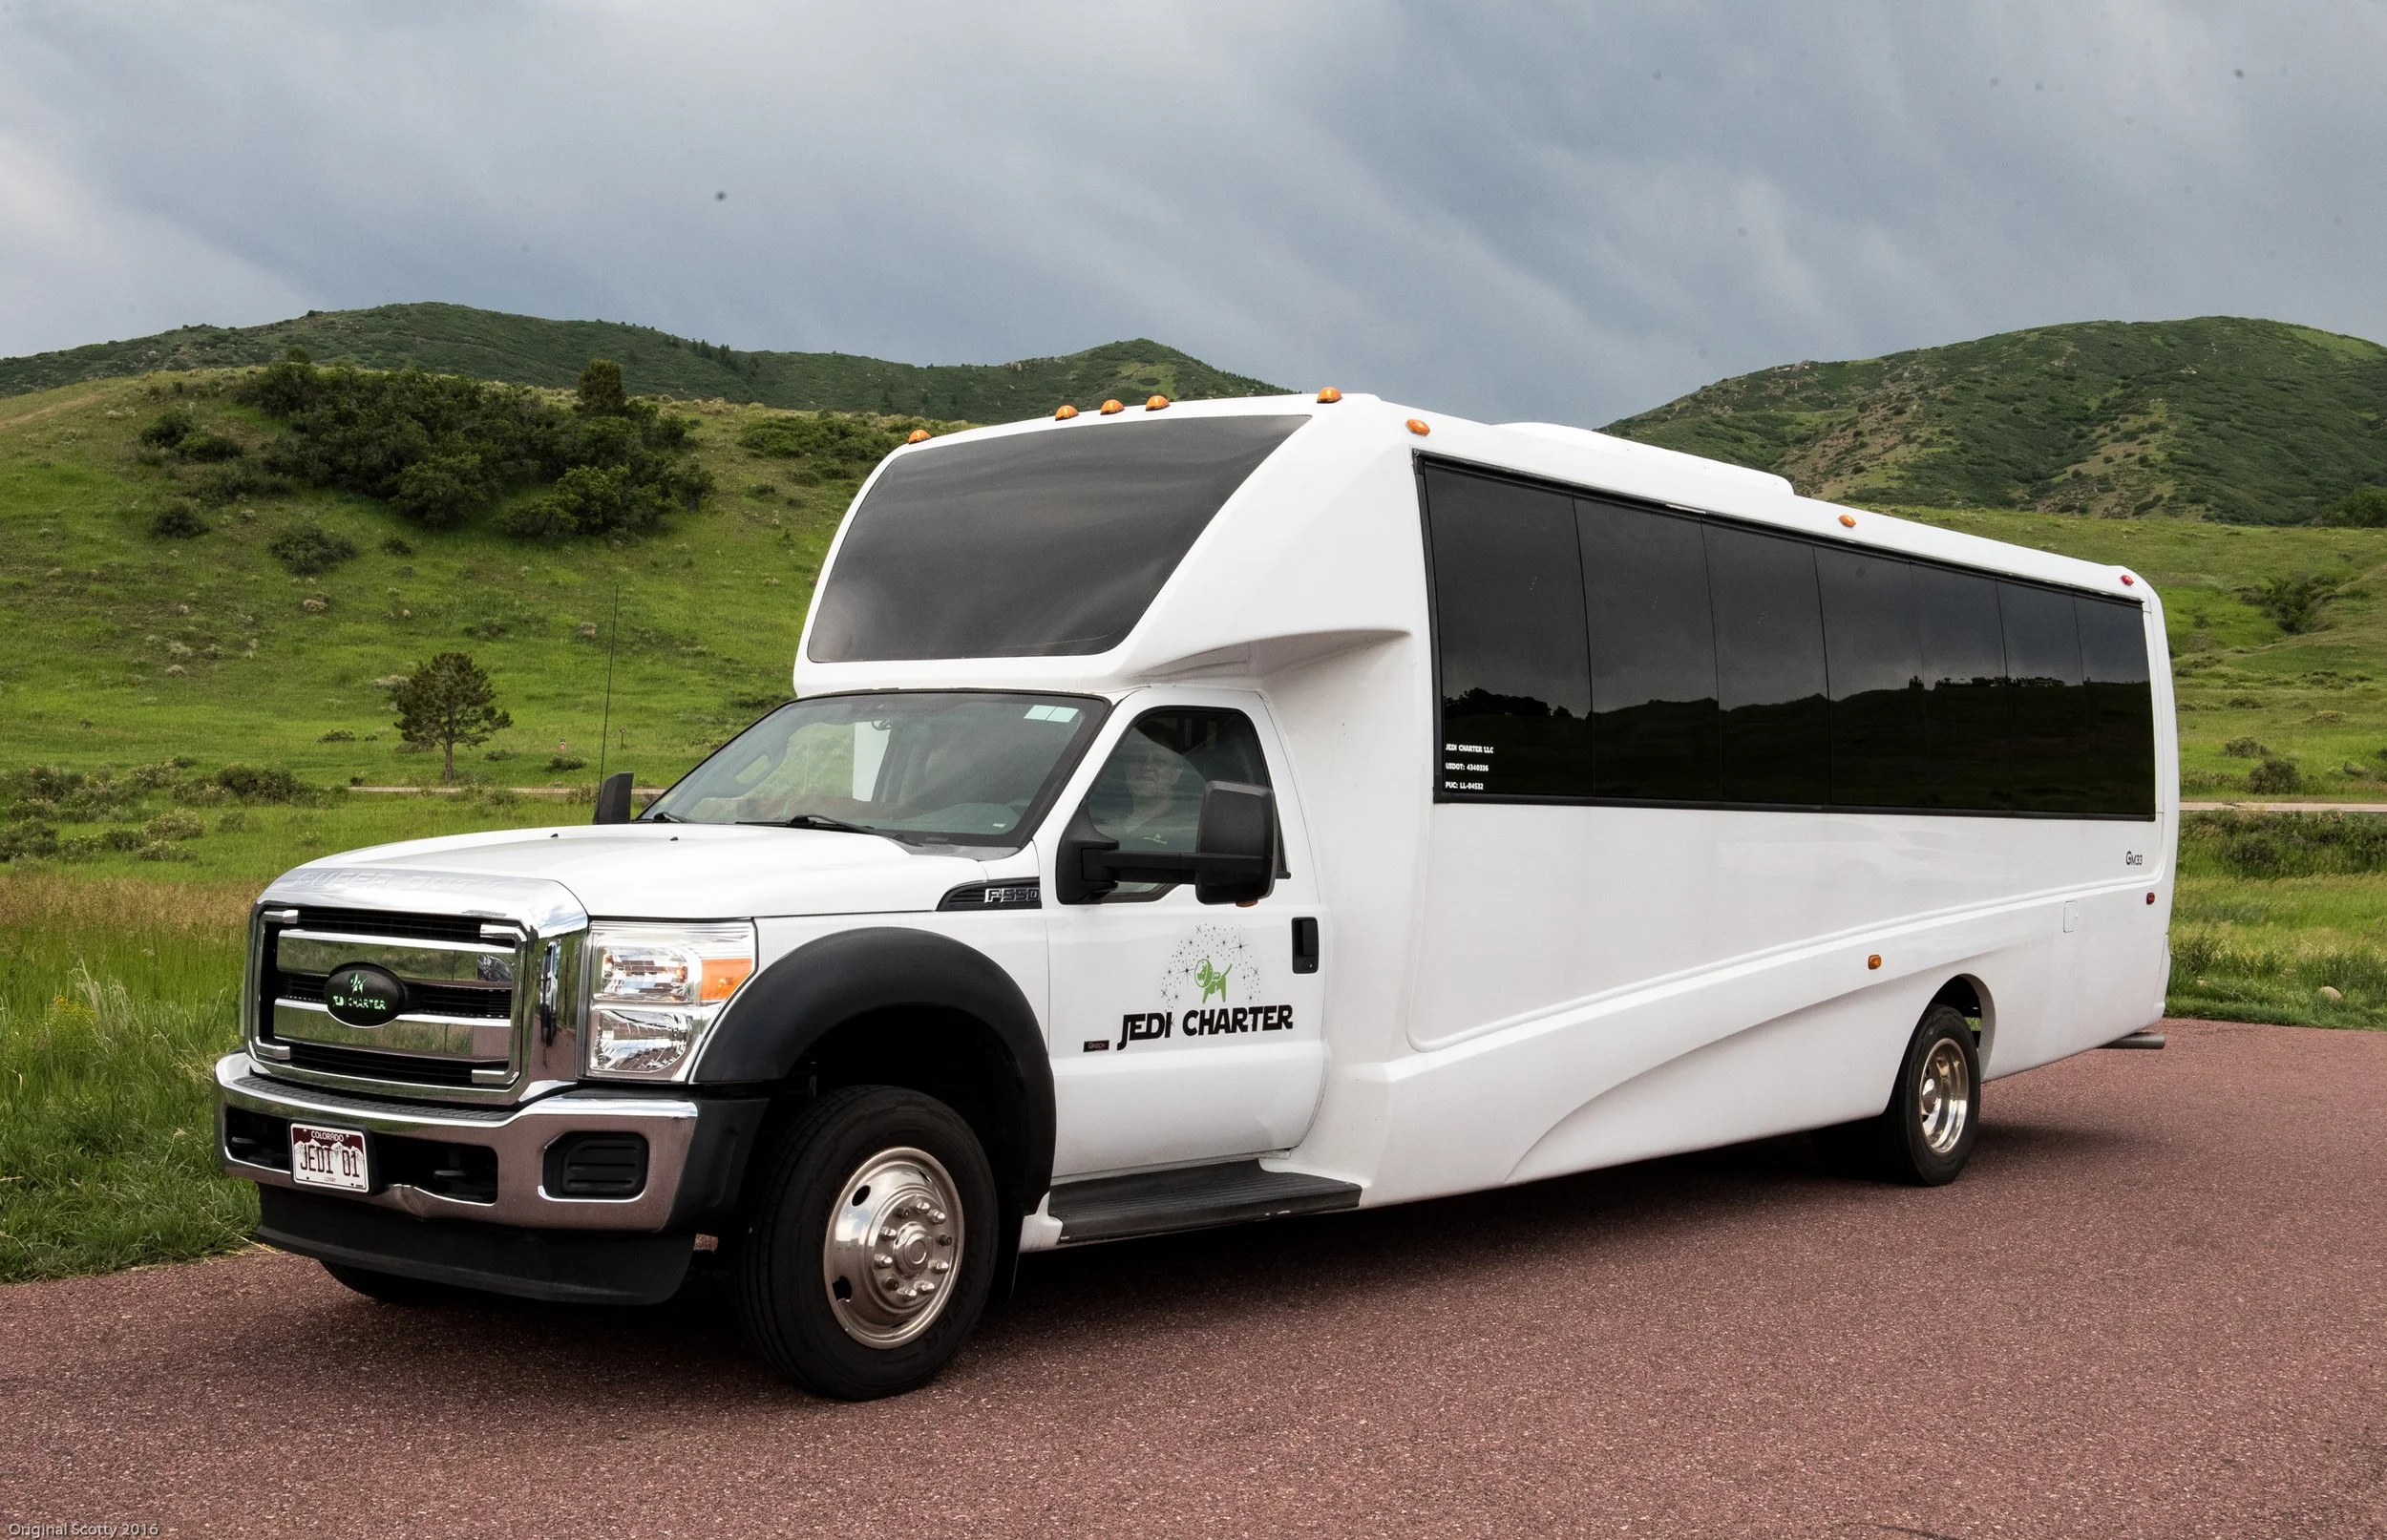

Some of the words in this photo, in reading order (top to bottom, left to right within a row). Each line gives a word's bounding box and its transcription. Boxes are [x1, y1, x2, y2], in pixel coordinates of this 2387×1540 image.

[348, 998, 386, 1009] CHARTER
[1117, 1012, 1172, 1051] JEDI
[1182, 1004, 1294, 1037] CHARTER
[311, 1131, 344, 1142] COLORADO
[301, 1145, 333, 1173] JEDI
